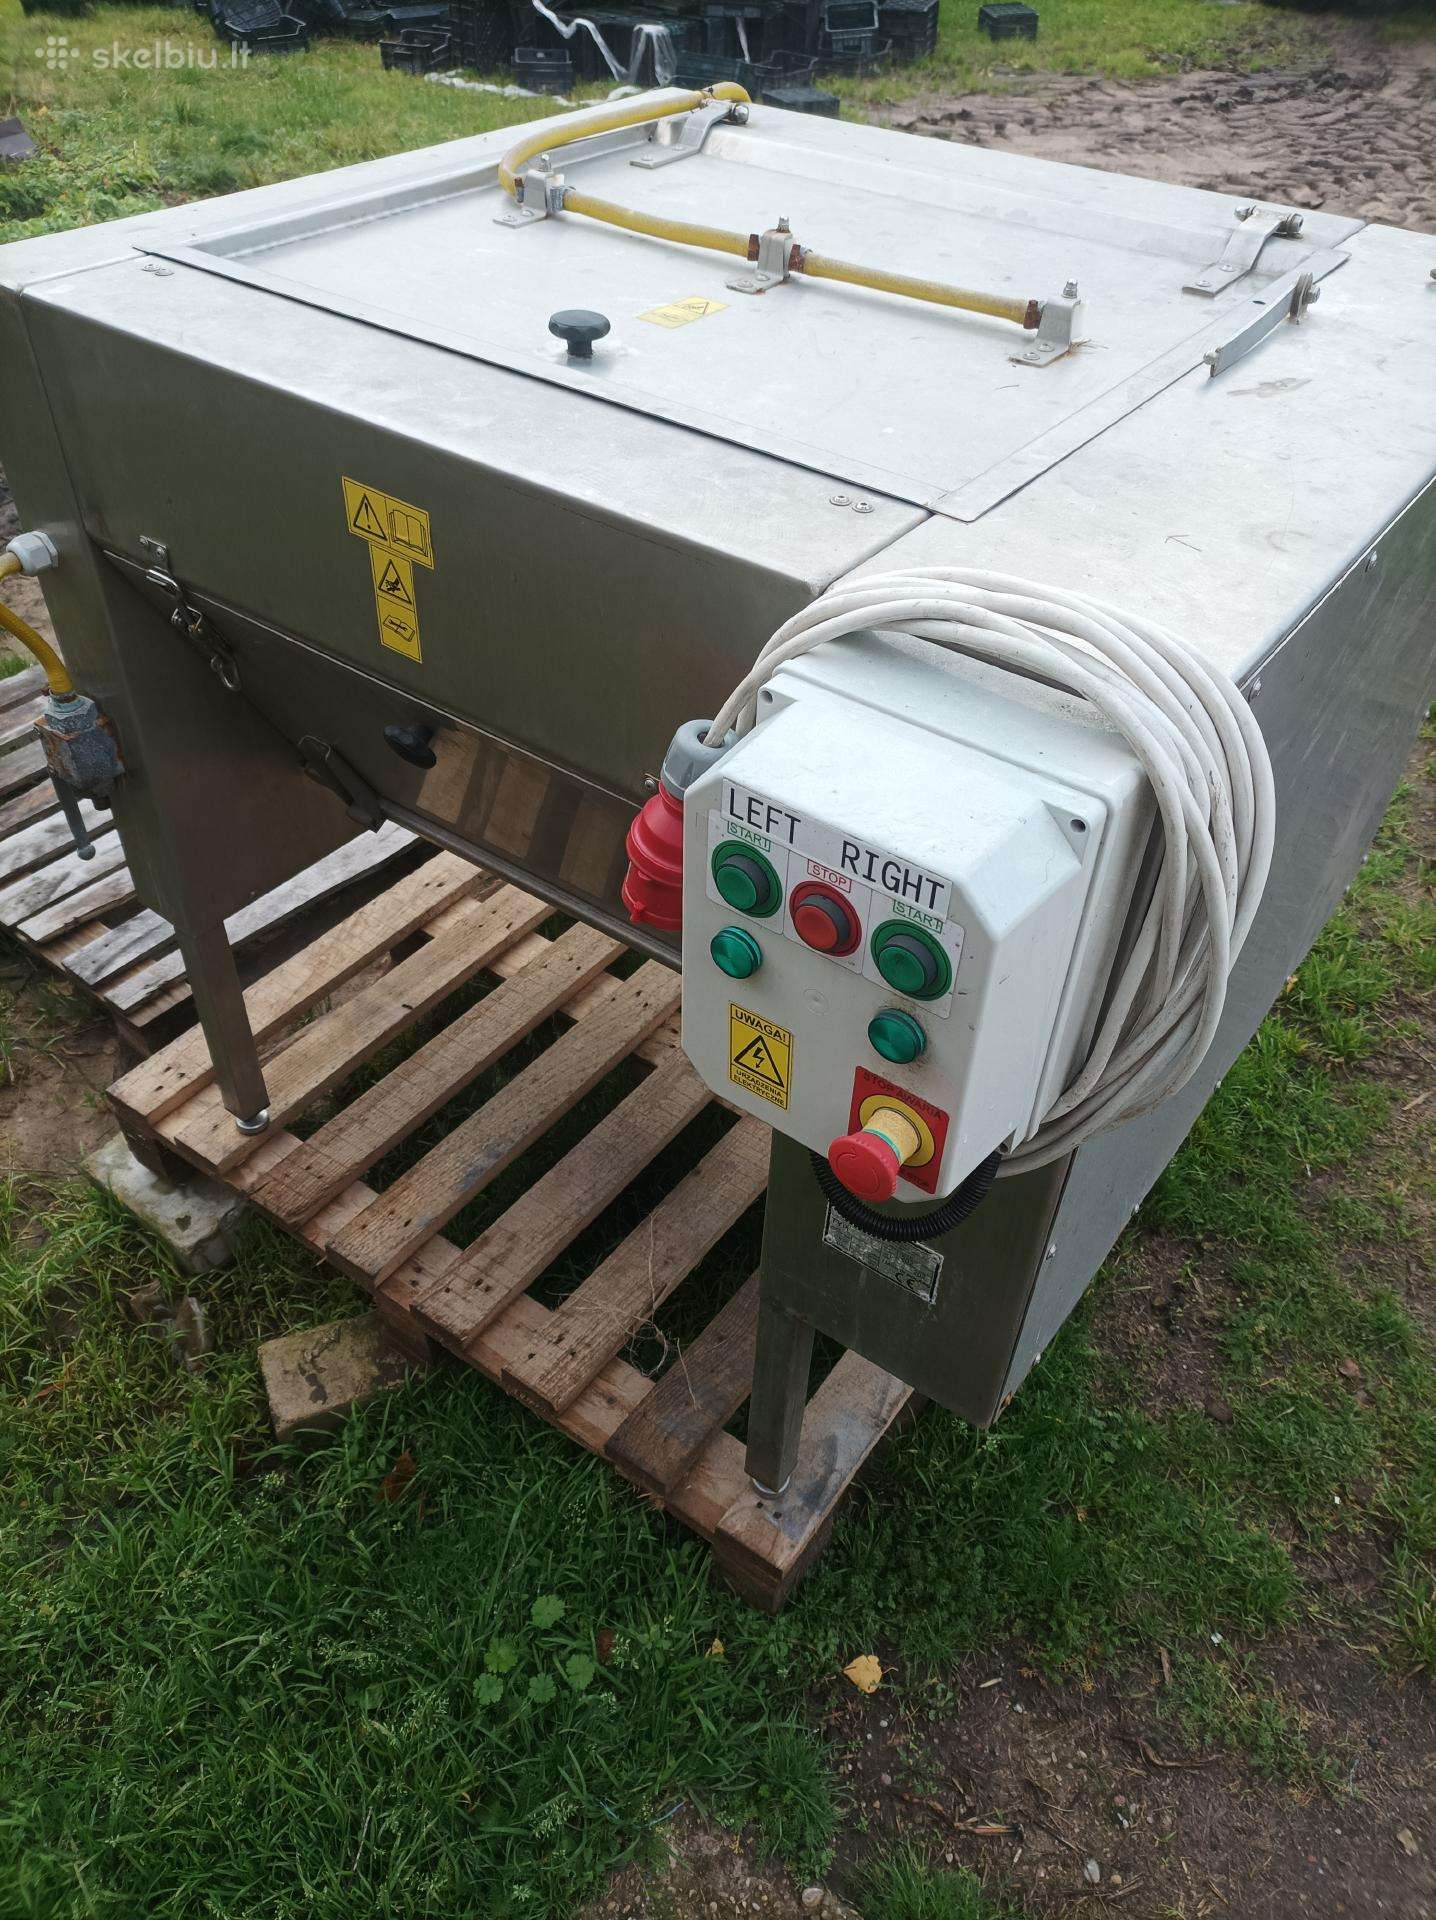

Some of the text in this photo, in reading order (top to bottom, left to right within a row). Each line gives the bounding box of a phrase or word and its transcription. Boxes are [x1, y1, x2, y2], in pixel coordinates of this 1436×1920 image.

[729, 820, 770, 850] START
[729, 787, 945, 911] LEFT RIGHT
[811, 863, 847, 888] STOP
[894, 901, 943, 933] START
[735, 1009, 786, 1043] UWAGA!
[863, 1070, 894, 1093] STOP
